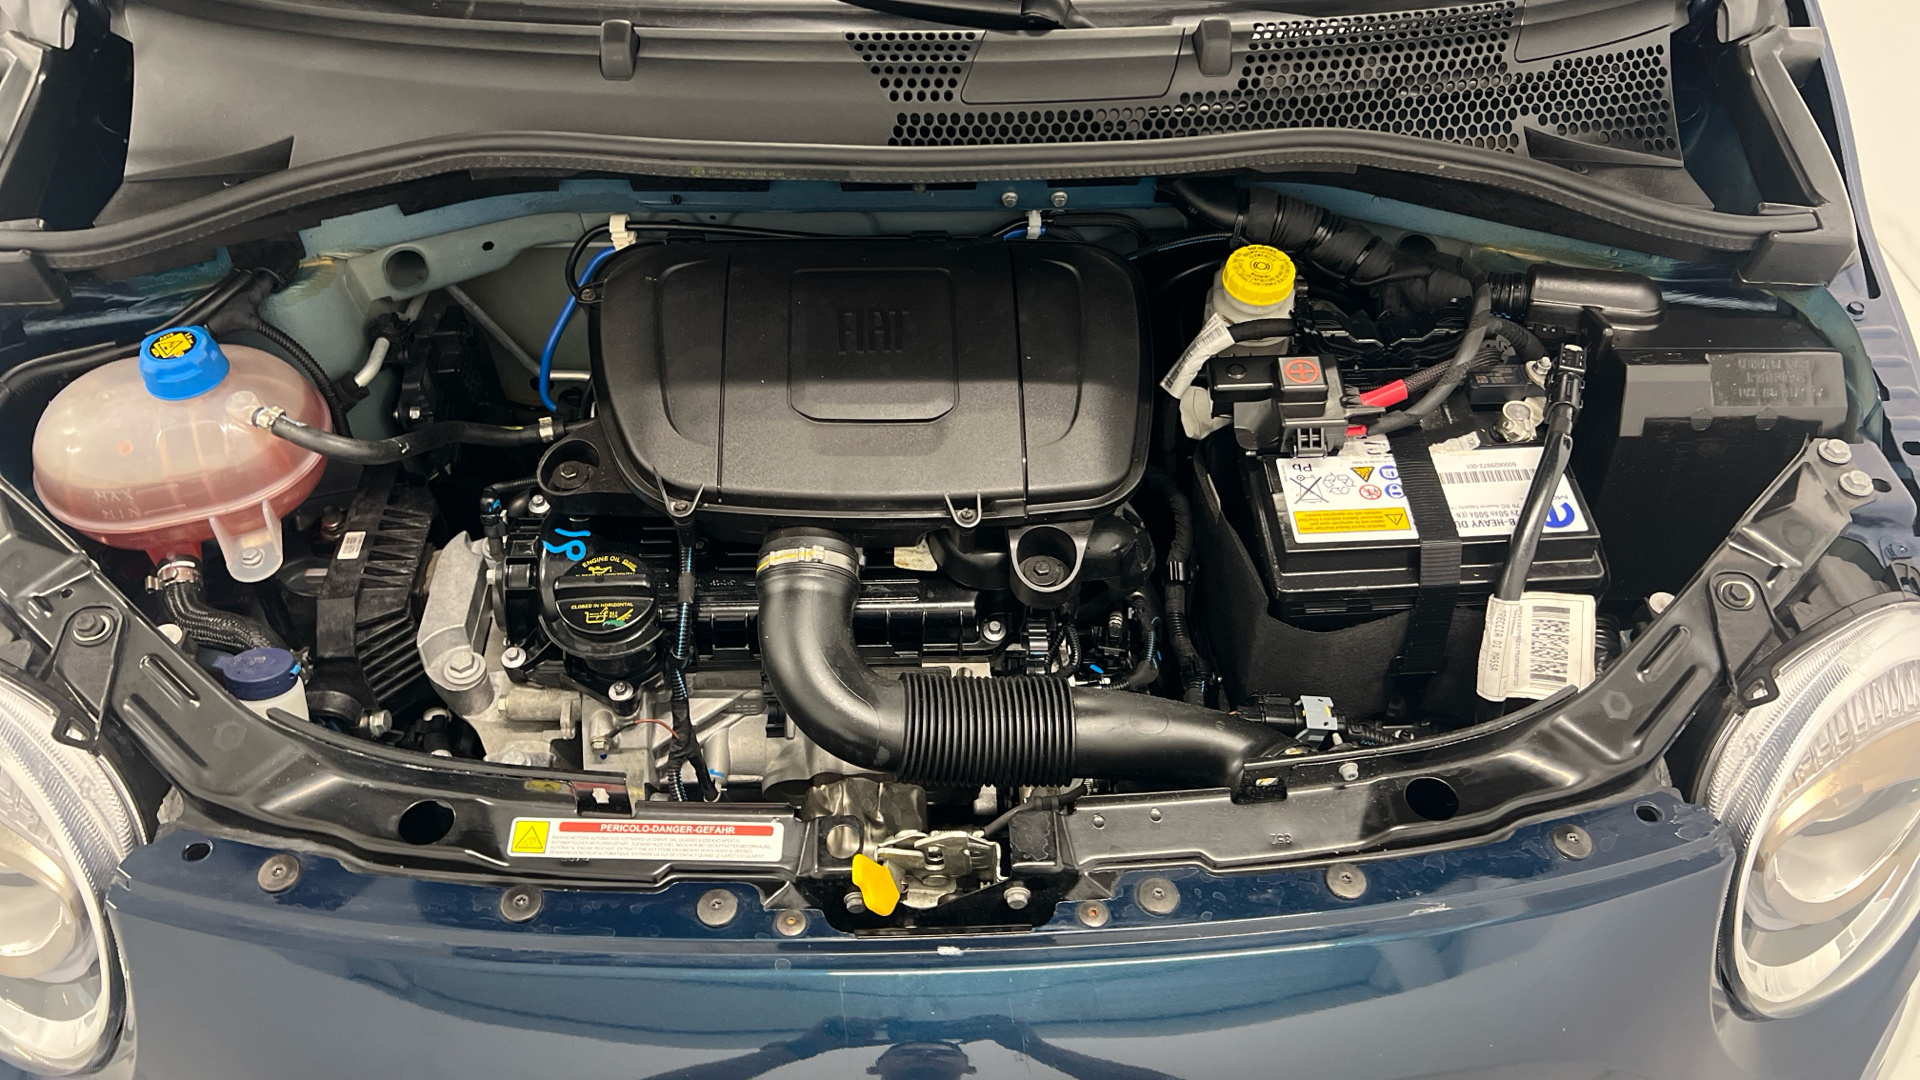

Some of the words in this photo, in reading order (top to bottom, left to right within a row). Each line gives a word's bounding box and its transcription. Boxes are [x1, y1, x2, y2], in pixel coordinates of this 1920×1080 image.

[838, 308, 910, 354] FIAT
[1292, 463, 1313, 472] Pb
[101, 507, 142, 520] MIN
[1472, 518, 1516, 528] B-HEAVY
[581, 555, 609, 568] ENGINE
[610, 555, 621, 563] OIL
[1492, 640, 1503, 649] DI
[1489, 652, 1501, 672] MASSA
[600, 823, 735, 834] PERICOLO-DANGER-GEFAHR
